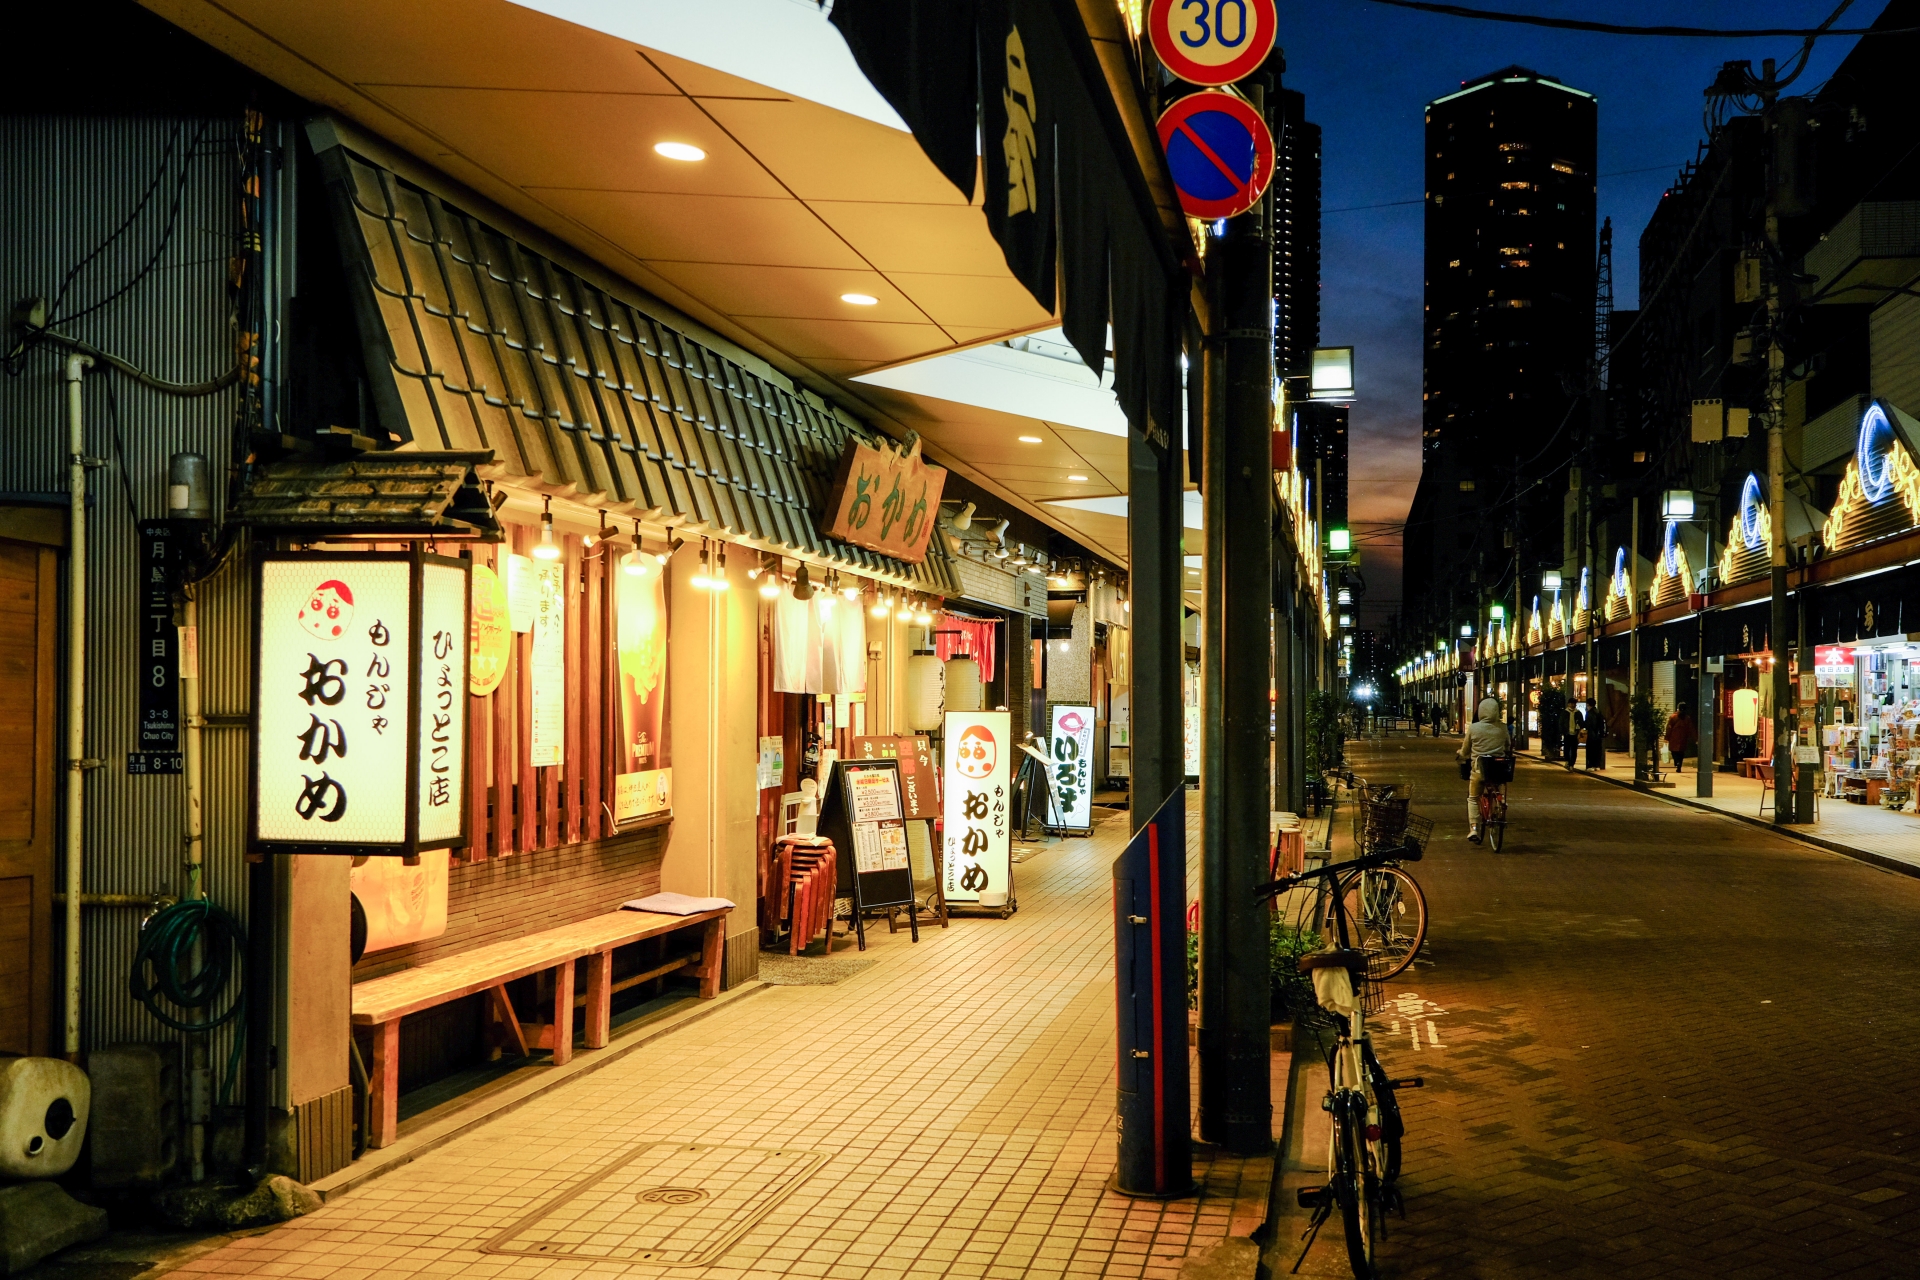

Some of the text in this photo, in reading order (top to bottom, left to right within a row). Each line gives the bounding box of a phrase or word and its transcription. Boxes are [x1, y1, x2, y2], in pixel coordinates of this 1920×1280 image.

[1180, 0, 1246, 48] 30
[848, 461, 927, 547] おかめ
[146, 528, 170, 537] 中央区
[366, 618, 391, 736] もんじゃ
[1825, 647, 1843, 665] 本
[143, 721, 175, 730] Tsukishima
[143, 731, 174, 741] Chuo City
[149, 709, 169, 719] 3-8
[295, 652, 349, 823] おかめ
[429, 630, 453, 807] ひょっとこ店
[917, 740, 929, 767] 只今
[1054, 735, 1080, 813] いろは
[1077, 758, 1087, 795] もんじゃ
[992, 784, 1005, 839] もんじゃ
[960, 790, 990, 893] おかめ
